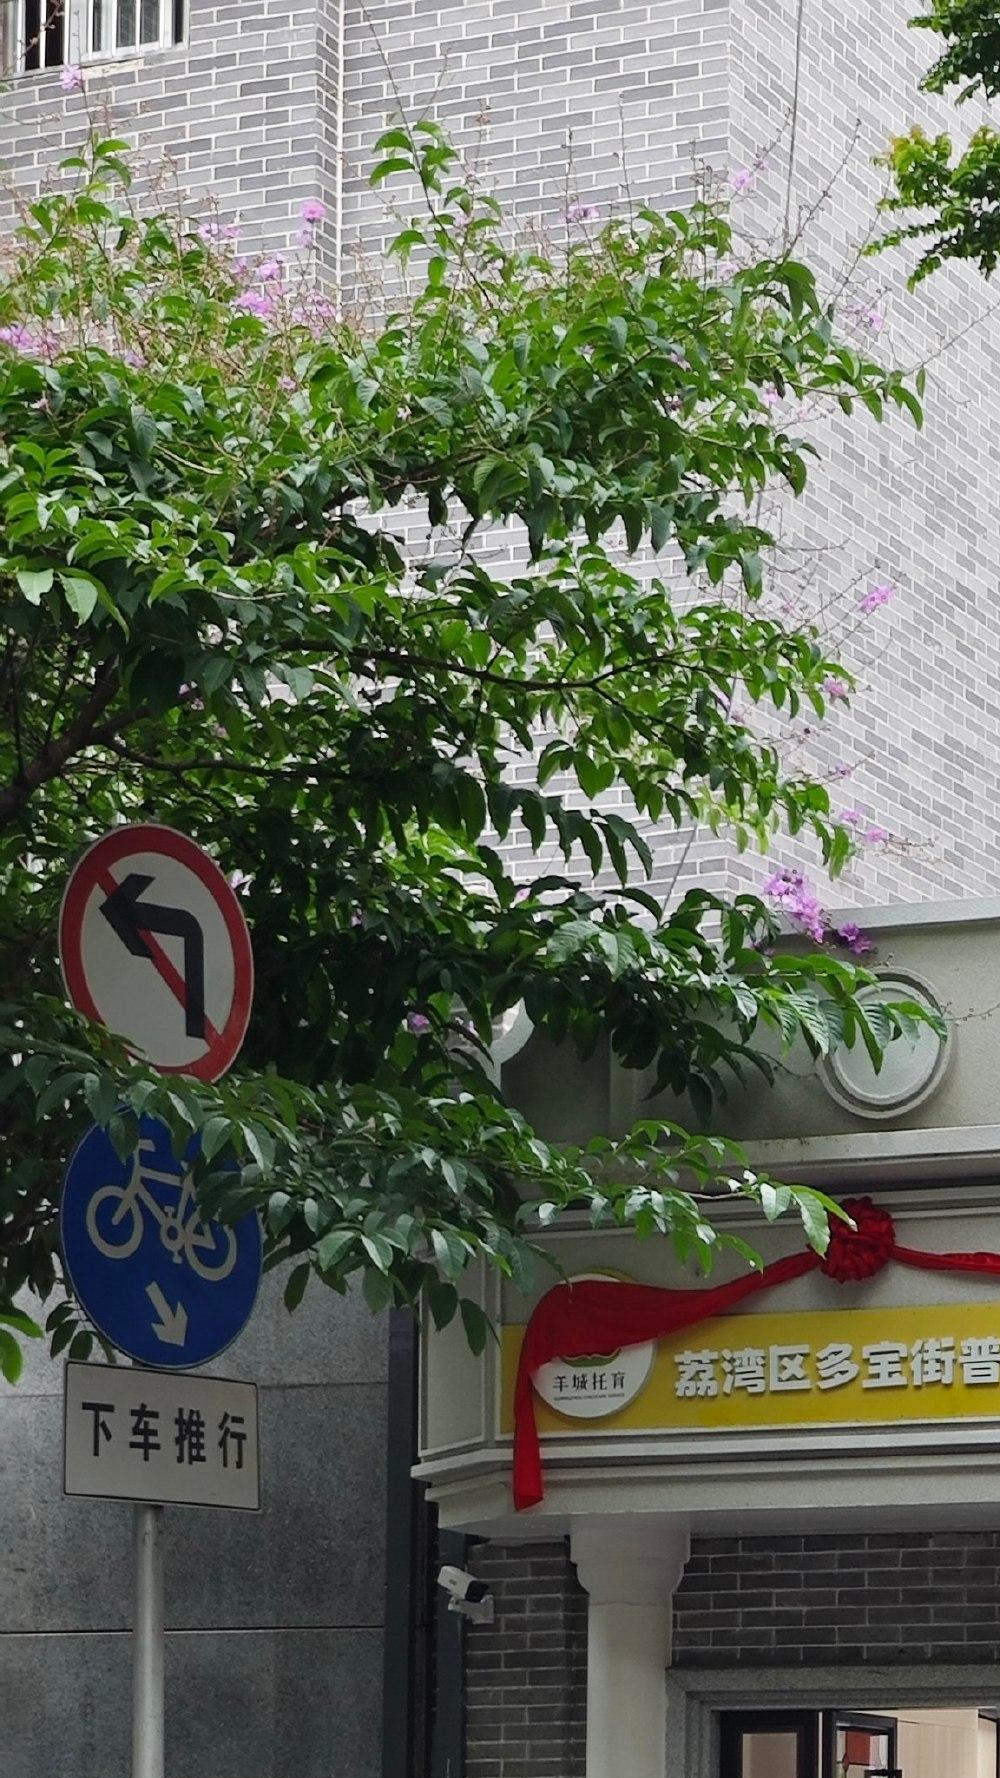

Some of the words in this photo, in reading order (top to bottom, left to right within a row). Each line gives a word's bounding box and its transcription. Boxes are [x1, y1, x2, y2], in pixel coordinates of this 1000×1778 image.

[553, 1370, 626, 1393] 羊城托育
[81, 1401, 247, 1469] 下车推行
